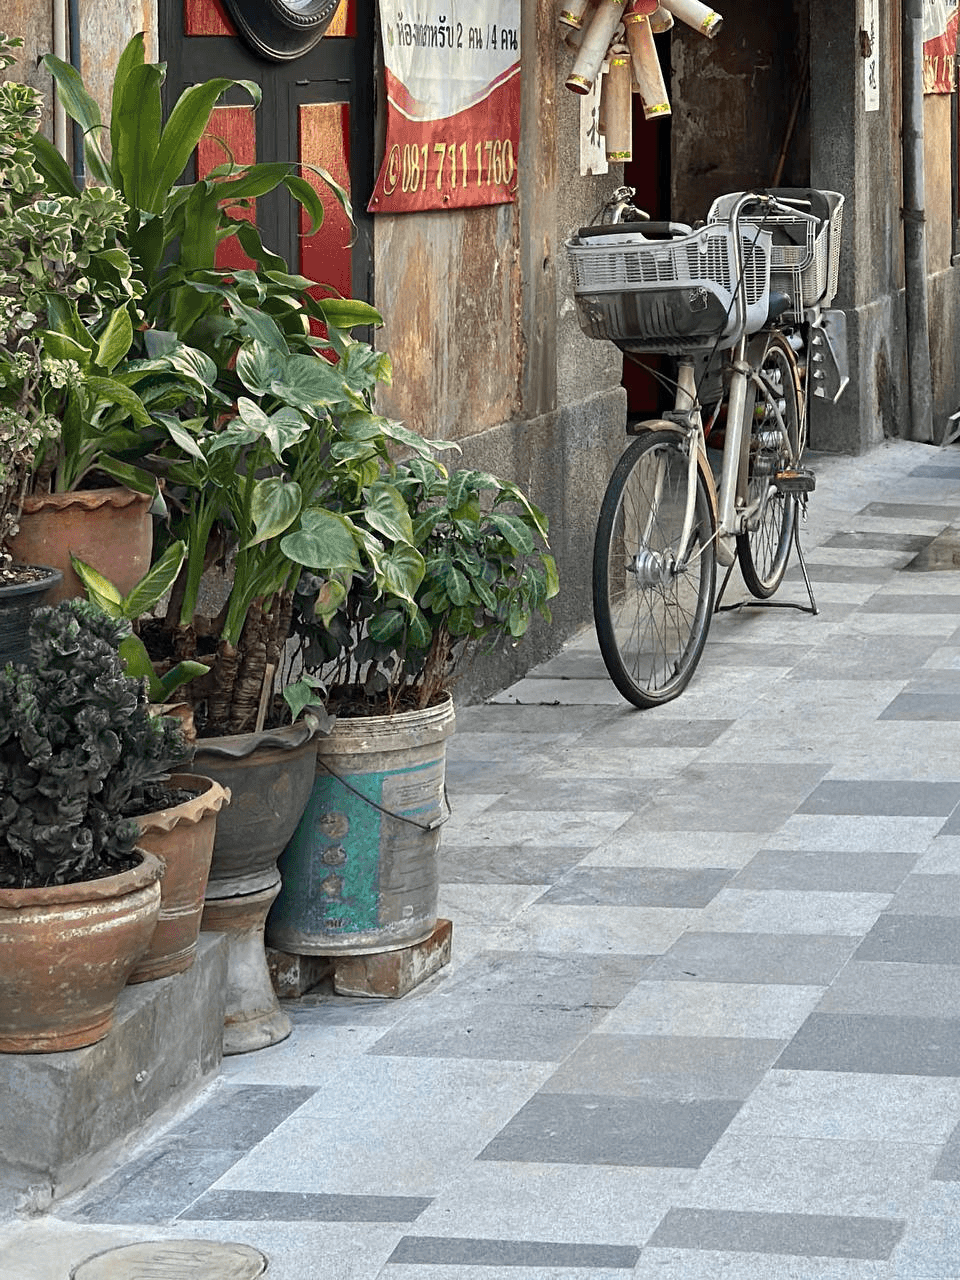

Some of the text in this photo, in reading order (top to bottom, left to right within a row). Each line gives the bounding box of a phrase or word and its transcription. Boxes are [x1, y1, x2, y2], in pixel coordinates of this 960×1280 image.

[501, 29, 518, 51] คน
[402, 143, 428, 193] 081
[433, 142, 467, 191] 711
